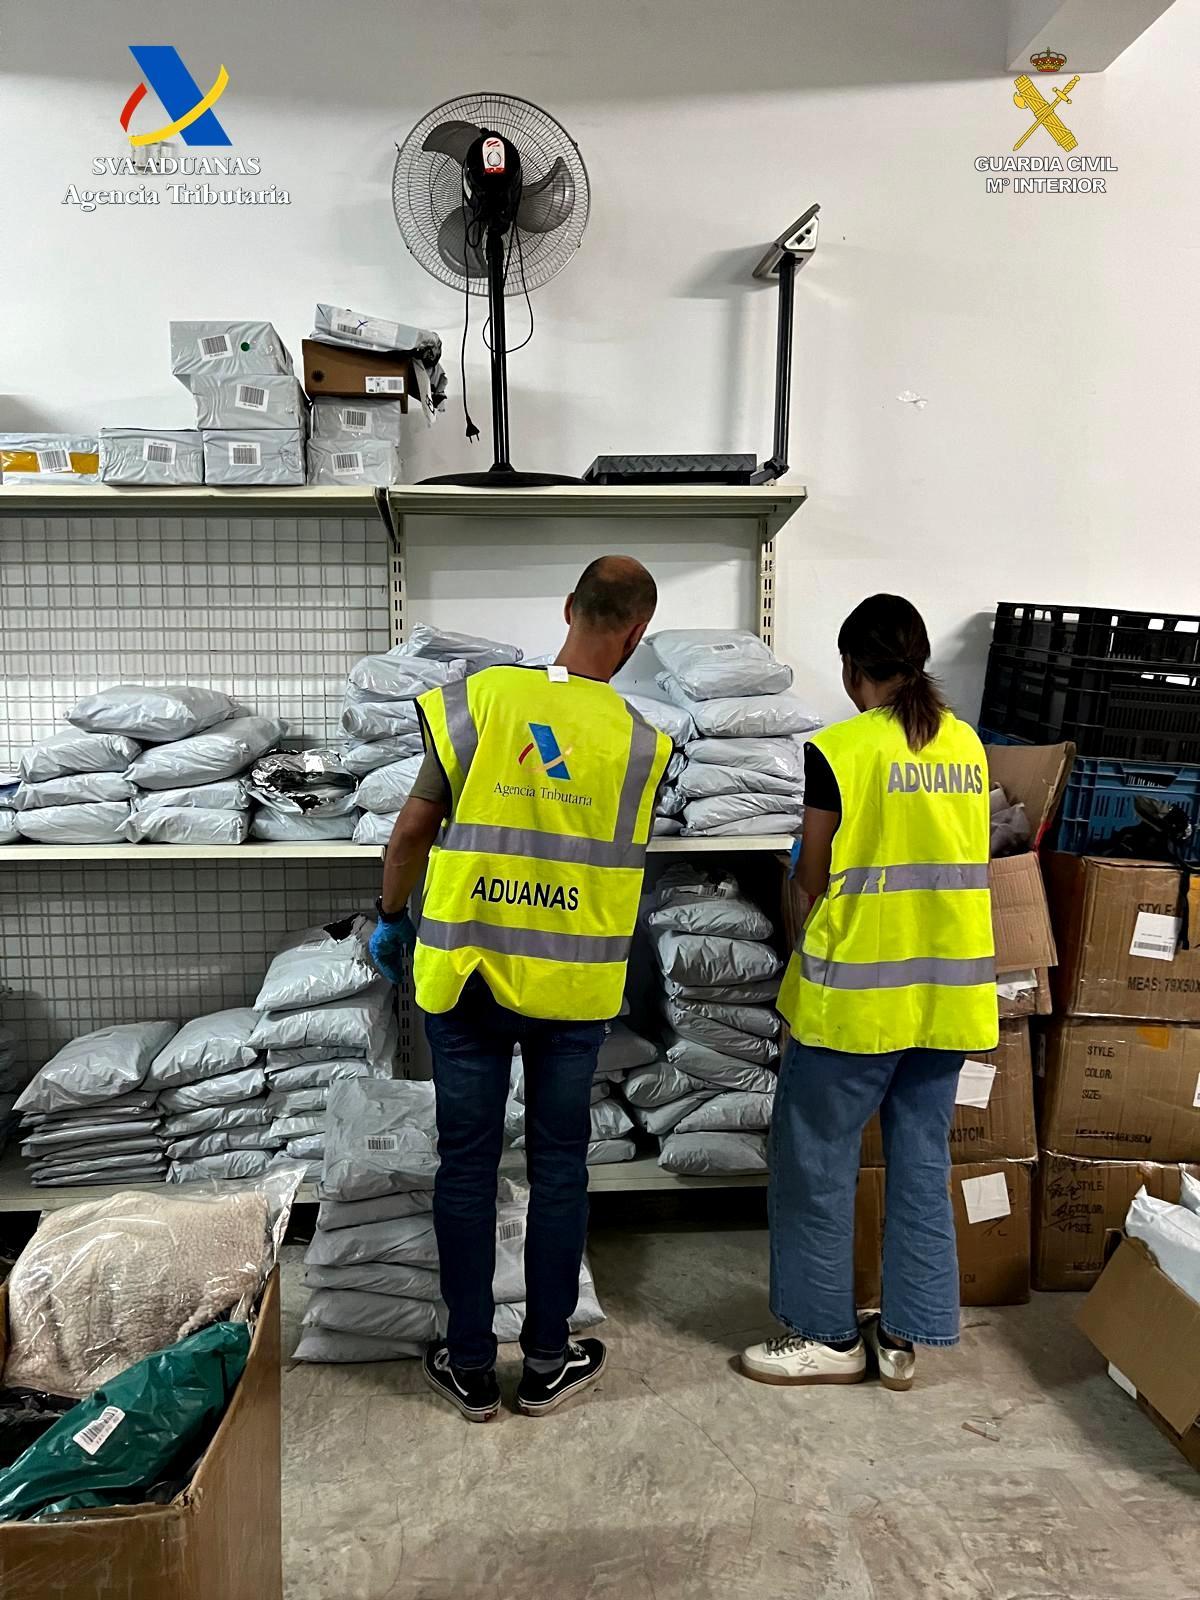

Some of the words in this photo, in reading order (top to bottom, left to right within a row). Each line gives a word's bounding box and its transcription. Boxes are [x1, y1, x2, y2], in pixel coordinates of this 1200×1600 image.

[887, 762, 983, 794] ADUANAS
[493, 782, 535, 797] Agencia
[540, 786, 593, 806] Tributaria
[470, 876, 579, 911] ADUANAS
[947, 1126, 985, 1142] X37CM
